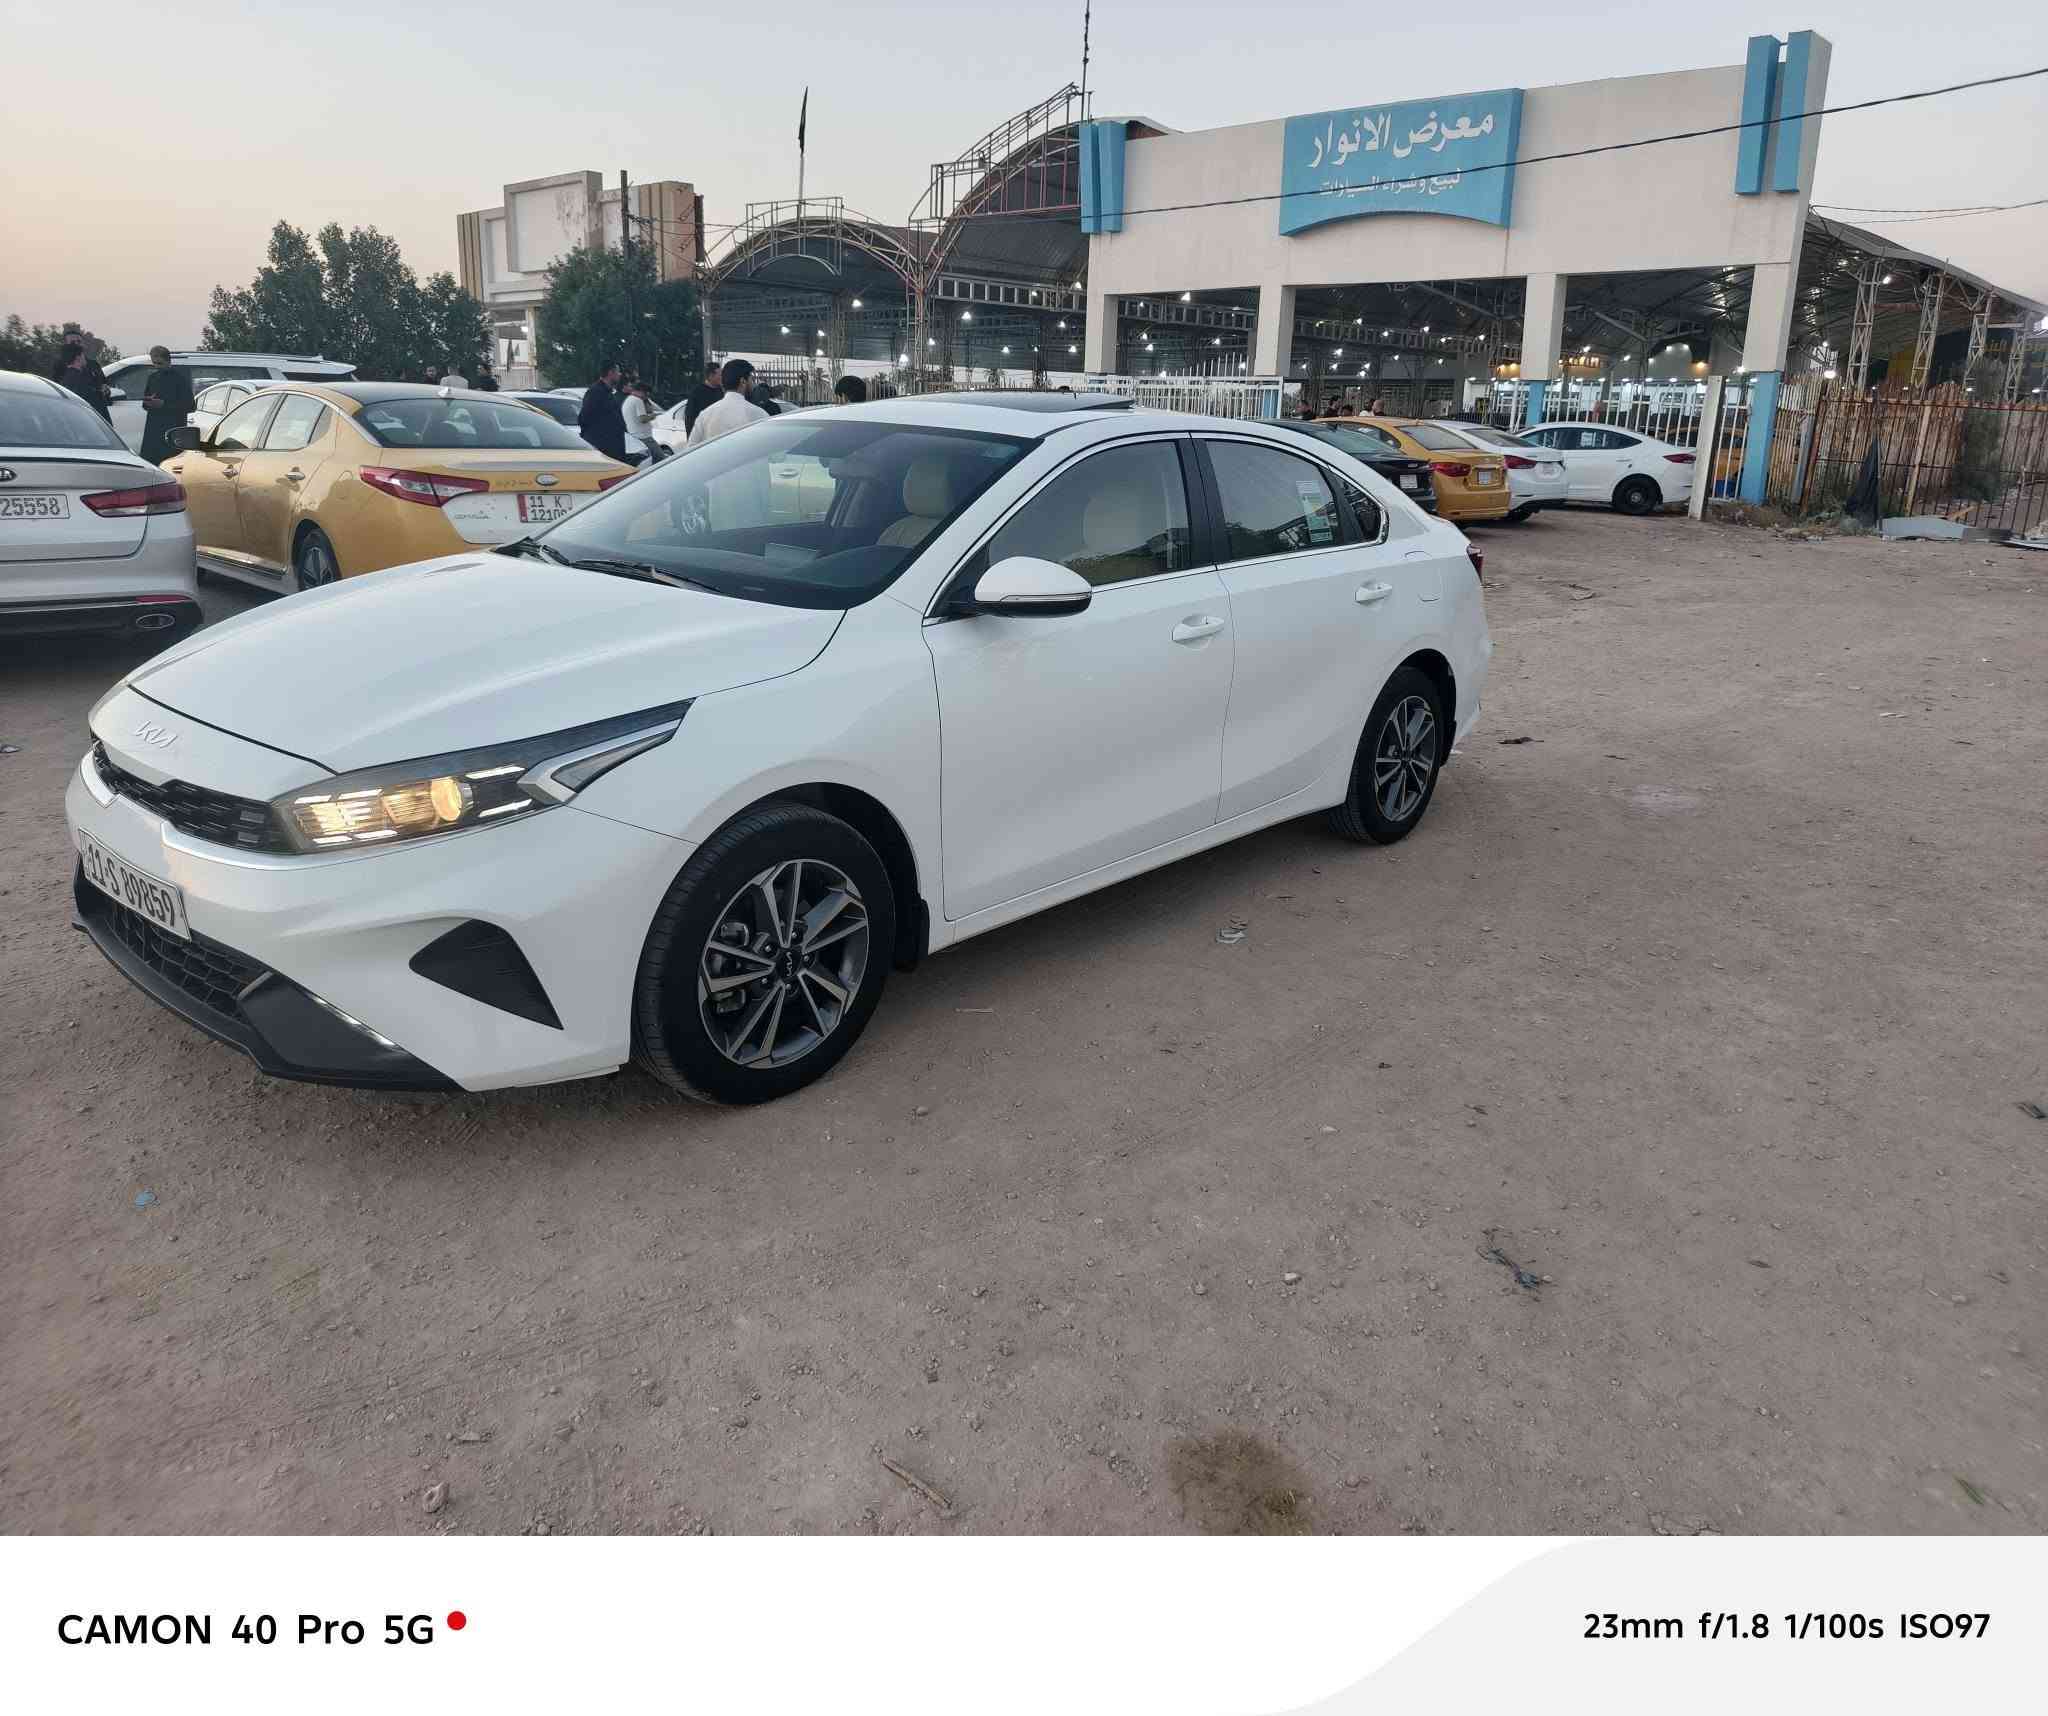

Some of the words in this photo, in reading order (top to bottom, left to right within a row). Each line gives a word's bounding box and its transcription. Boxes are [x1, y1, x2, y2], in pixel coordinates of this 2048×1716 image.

[1307, 112, 1392, 168] الانوار
[1393, 111, 1495, 158] معرض
[0, 497, 60, 516] 25558
[529, 495, 545, 508] 11
[554, 495, 563, 508] K
